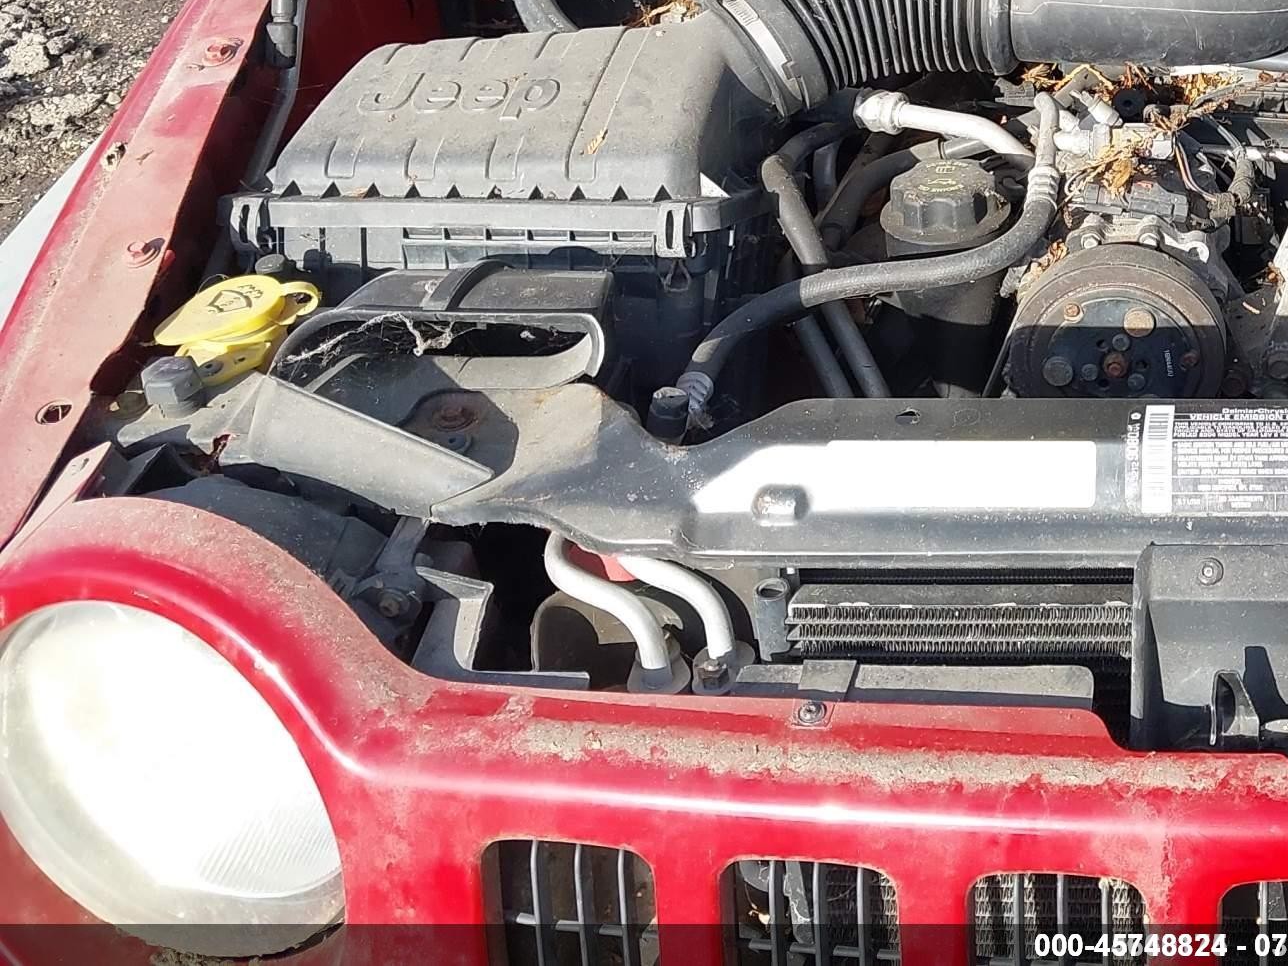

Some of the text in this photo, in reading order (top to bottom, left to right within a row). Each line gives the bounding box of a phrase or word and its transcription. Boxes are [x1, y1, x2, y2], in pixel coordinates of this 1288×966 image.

[357, 72, 561, 121] Jeep
[1189, 413, 1231, 421] VEHICLE
[1234, 413, 1283, 421] EMISSION
